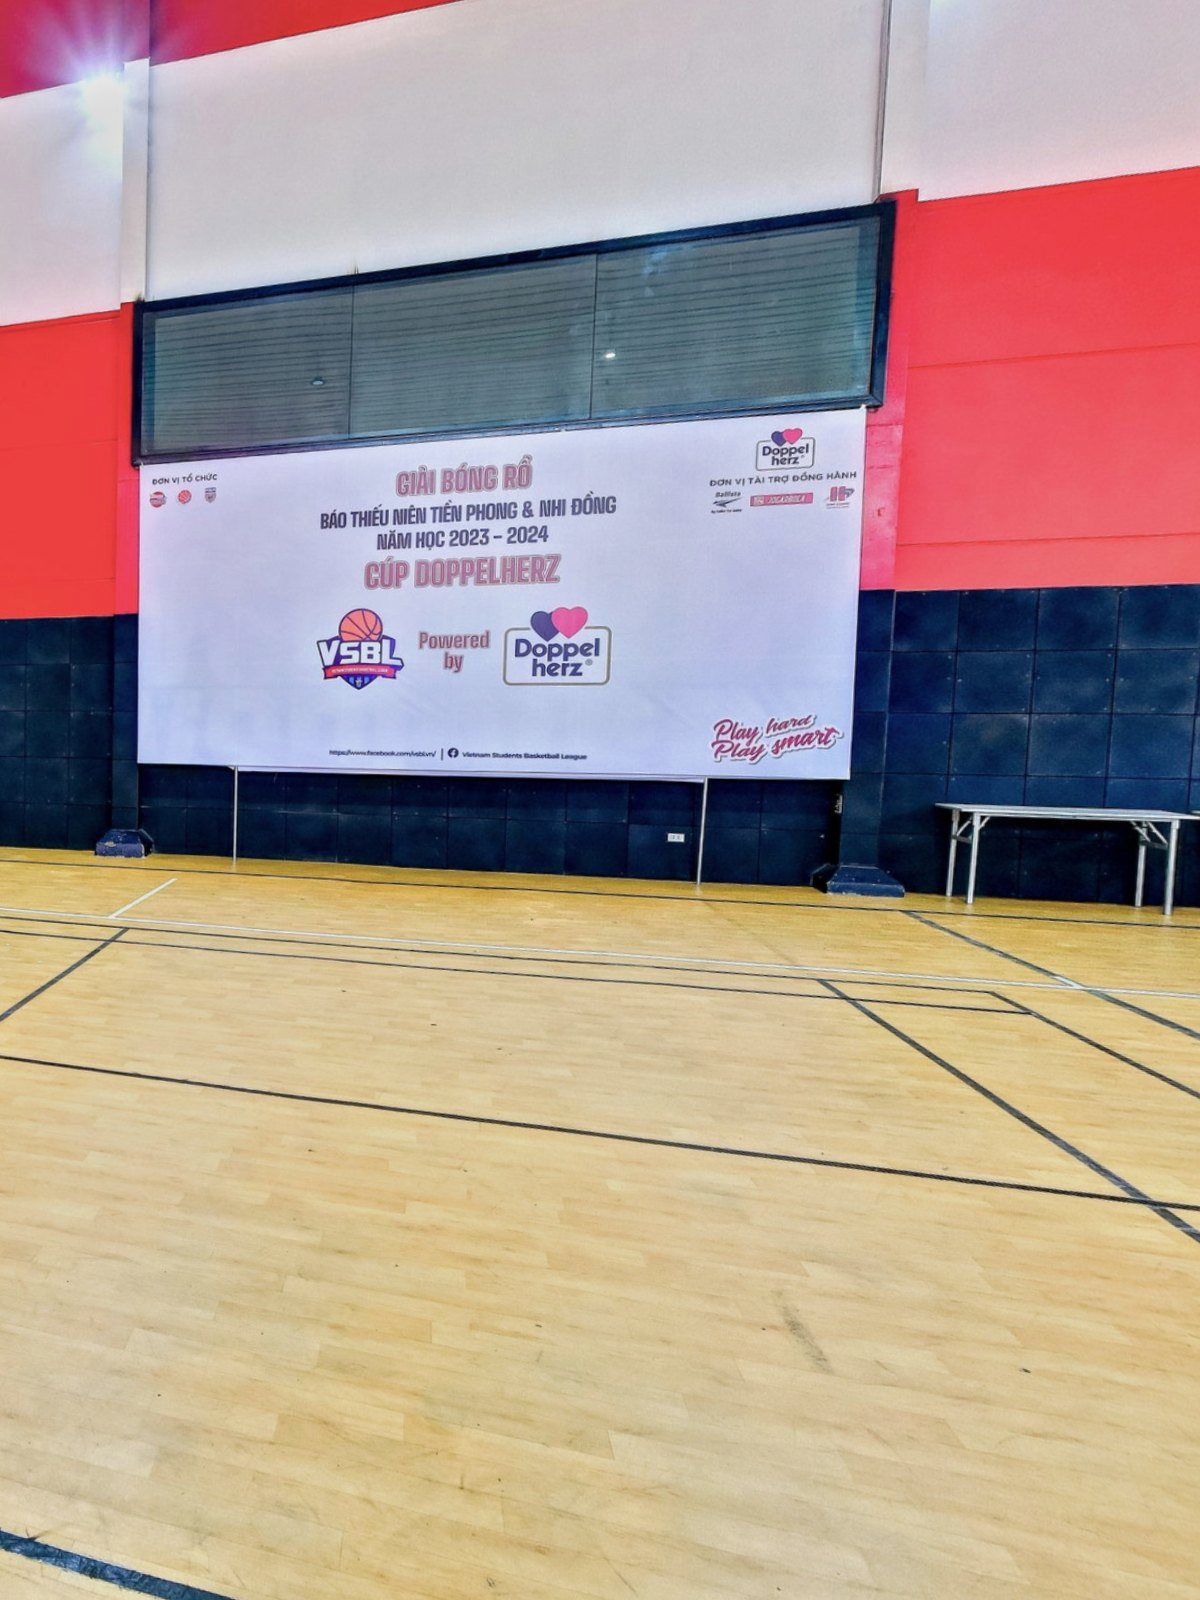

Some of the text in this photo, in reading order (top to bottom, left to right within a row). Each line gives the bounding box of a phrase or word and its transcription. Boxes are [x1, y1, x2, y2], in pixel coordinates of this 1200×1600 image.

[762, 443, 809, 458] Doppel
[771, 456, 799, 466] herz
[152, 477, 170, 485] ĐƠN
[396, 454, 533, 497] GIẢI BÓNG RỔ
[709, 478, 732, 487] ĐƠN
[736, 479, 746, 487] VỊ
[749, 476, 765, 485] TÀI
[768, 475, 789, 484] TRỢ
[320, 490, 617, 530] BÁO THIẾU NIÊN TIỀN PHONG & NHI ĐỒNG
[376, 530, 412, 551] NĂM
[415, 530, 445, 552] HỌC
[448, 528, 490, 548] 2023
[506, 525, 549, 545] 2024
[364, 553, 561, 590] CÚP DOPPELHERZ
[419, 629, 491, 650] Powered
[514, 638, 600, 661] Doppel
[317, 639, 404, 667] VSBL
[443, 652, 464, 673] by
[531, 658, 583, 677] herz
[713, 715, 812, 745] Play hard
[711, 727, 840, 761] Play smart
[492, 752, 523, 760] Students
